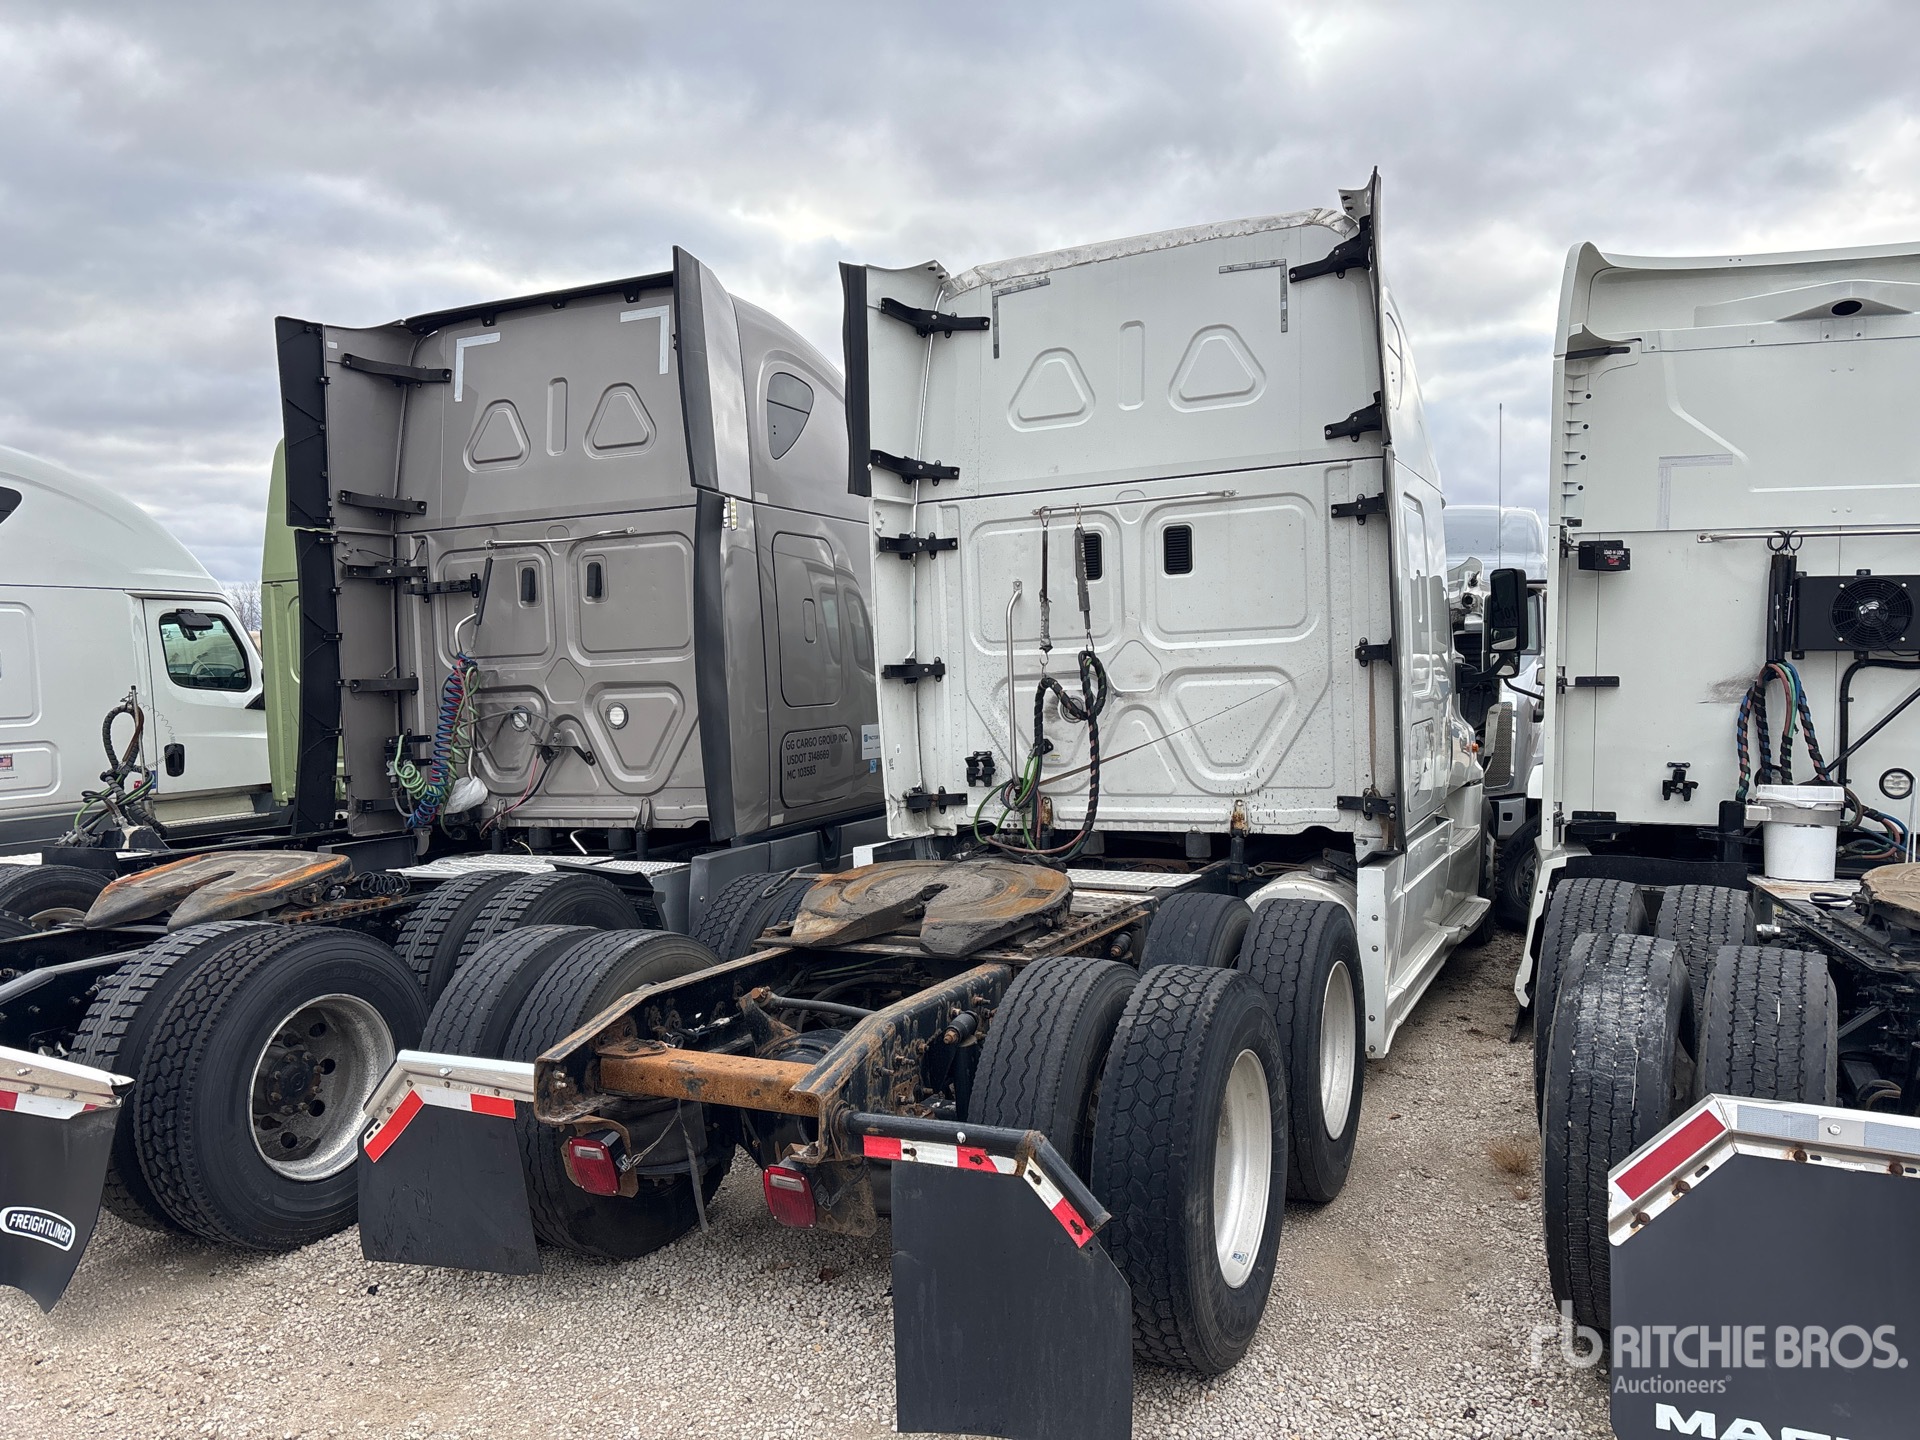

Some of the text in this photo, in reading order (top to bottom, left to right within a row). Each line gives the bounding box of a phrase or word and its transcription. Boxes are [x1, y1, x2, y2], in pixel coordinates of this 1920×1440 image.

[786, 740, 795, 750] GG
[796, 737, 817, 749] CARGO
[818, 734, 838, 746] GROUP
[786, 752, 807, 765] USDOT
[786, 769, 796, 781] MC
[8, 1213, 71, 1244] FREIGHTLINER
